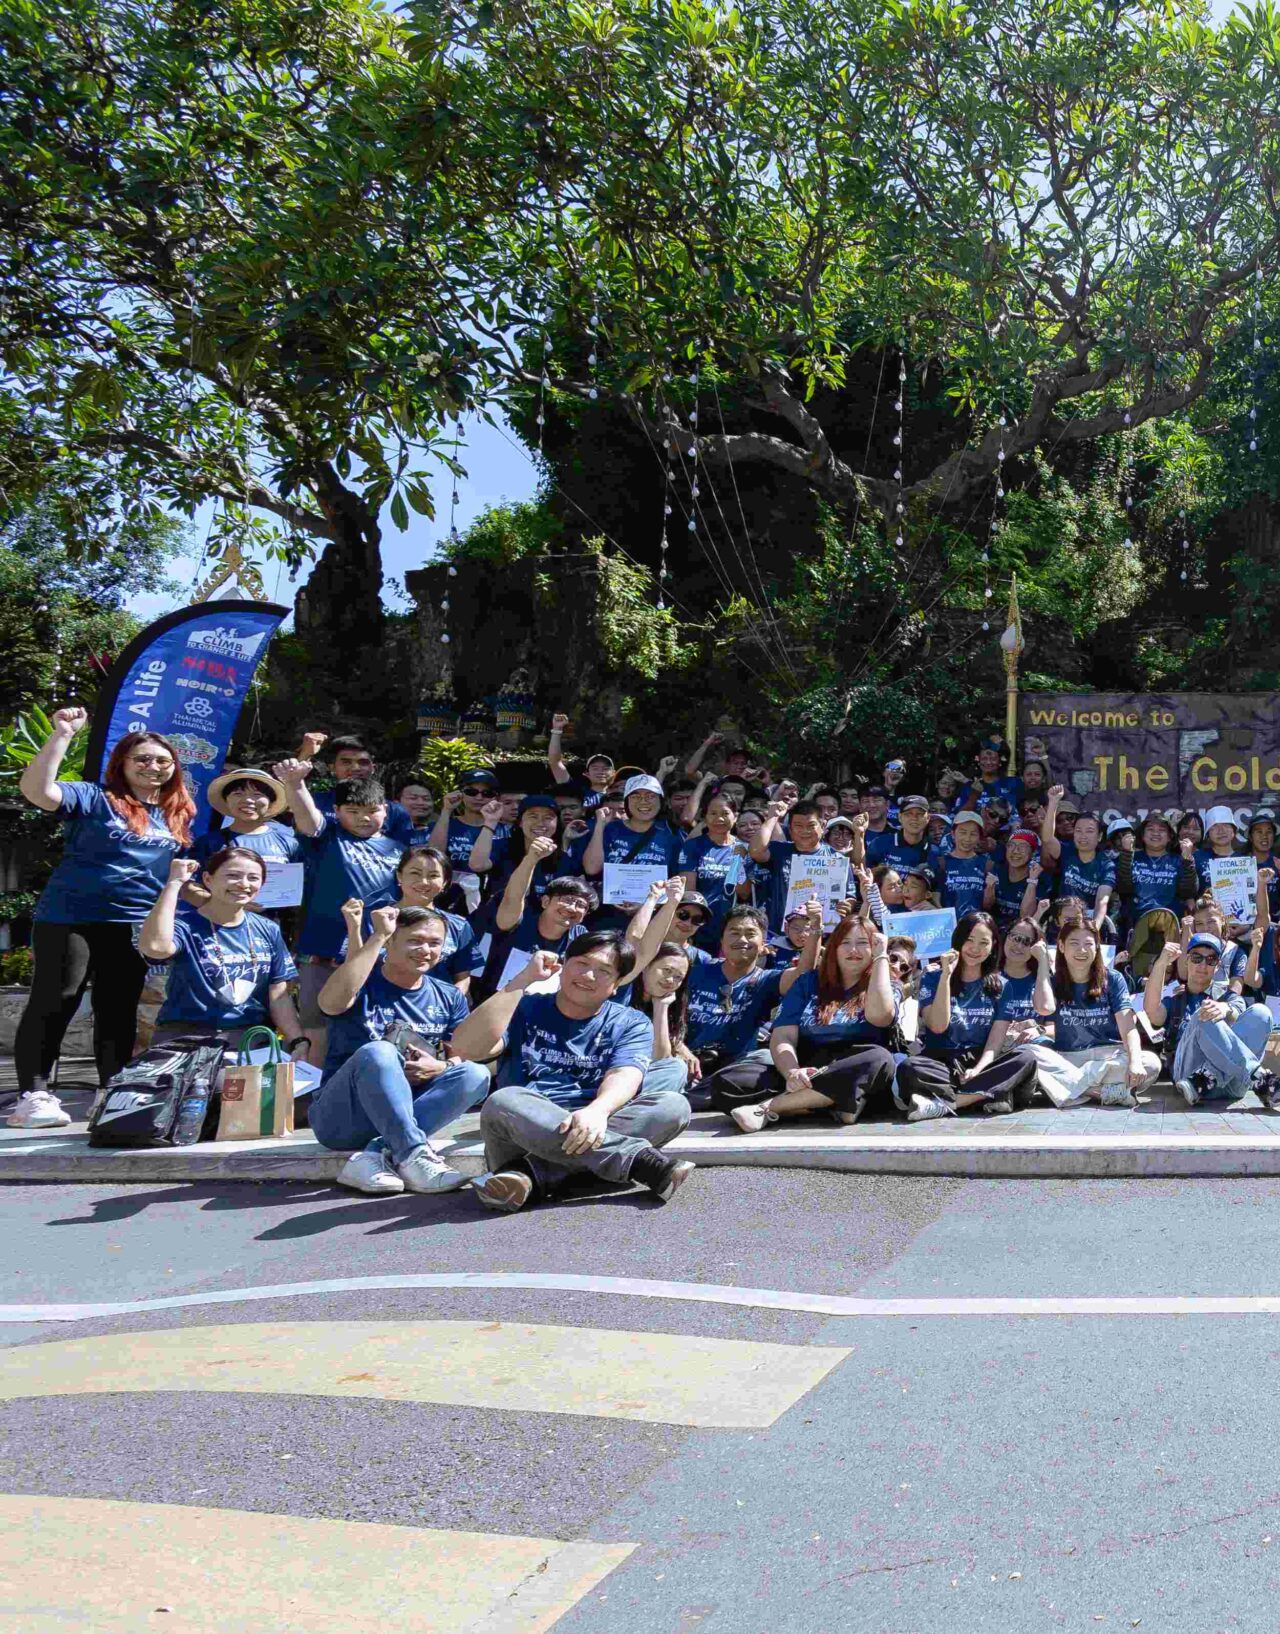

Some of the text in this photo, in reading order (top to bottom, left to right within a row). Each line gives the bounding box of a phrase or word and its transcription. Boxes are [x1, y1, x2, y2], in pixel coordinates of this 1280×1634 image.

[203, 635, 243, 651] CLIMB
[134, 660, 167, 698] Life
[128, 702, 154, 718] A
[1030, 706, 1175, 728] Welcome to
[1093, 755, 1169, 792] The
